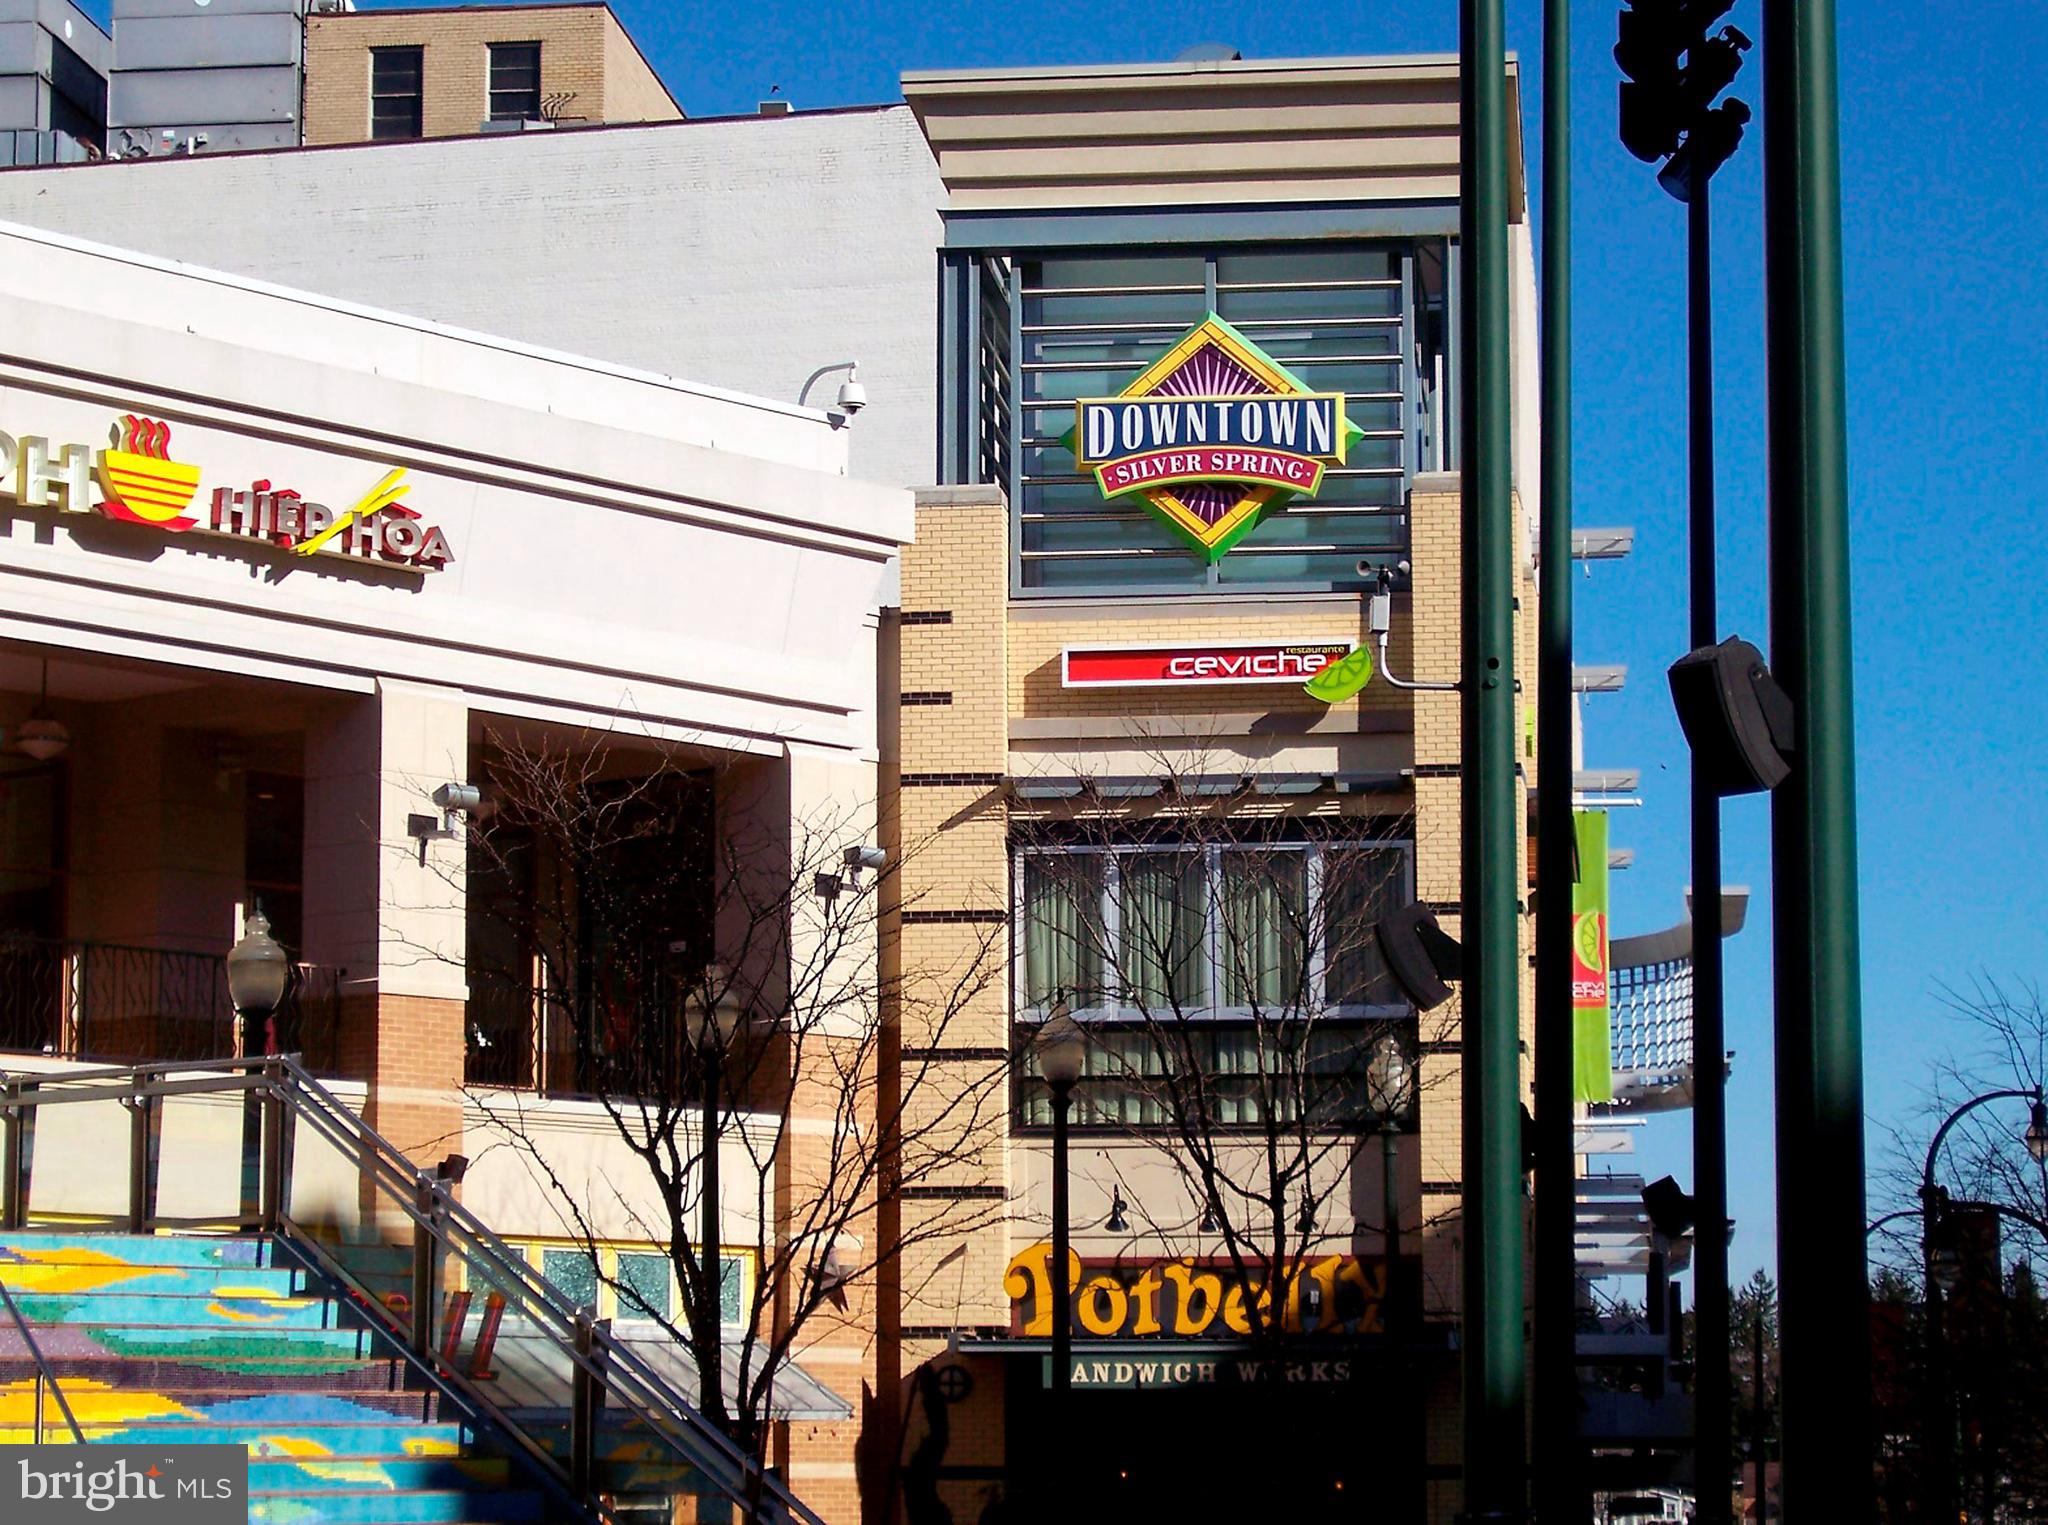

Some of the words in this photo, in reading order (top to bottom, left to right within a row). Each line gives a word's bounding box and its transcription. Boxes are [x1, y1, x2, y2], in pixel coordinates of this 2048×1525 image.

[1088, 400, 1330, 459] DOWNTOWN
[1115, 453, 1203, 485] SILVER
[1210, 452, 1305, 481] SPRING
[1169, 650, 1327, 676] ceviche
[1284, 645, 1345, 655] restaurante
[1069, 1362, 1217, 1384] ANDWICH
[1237, 1362, 1351, 1384] WRKS
